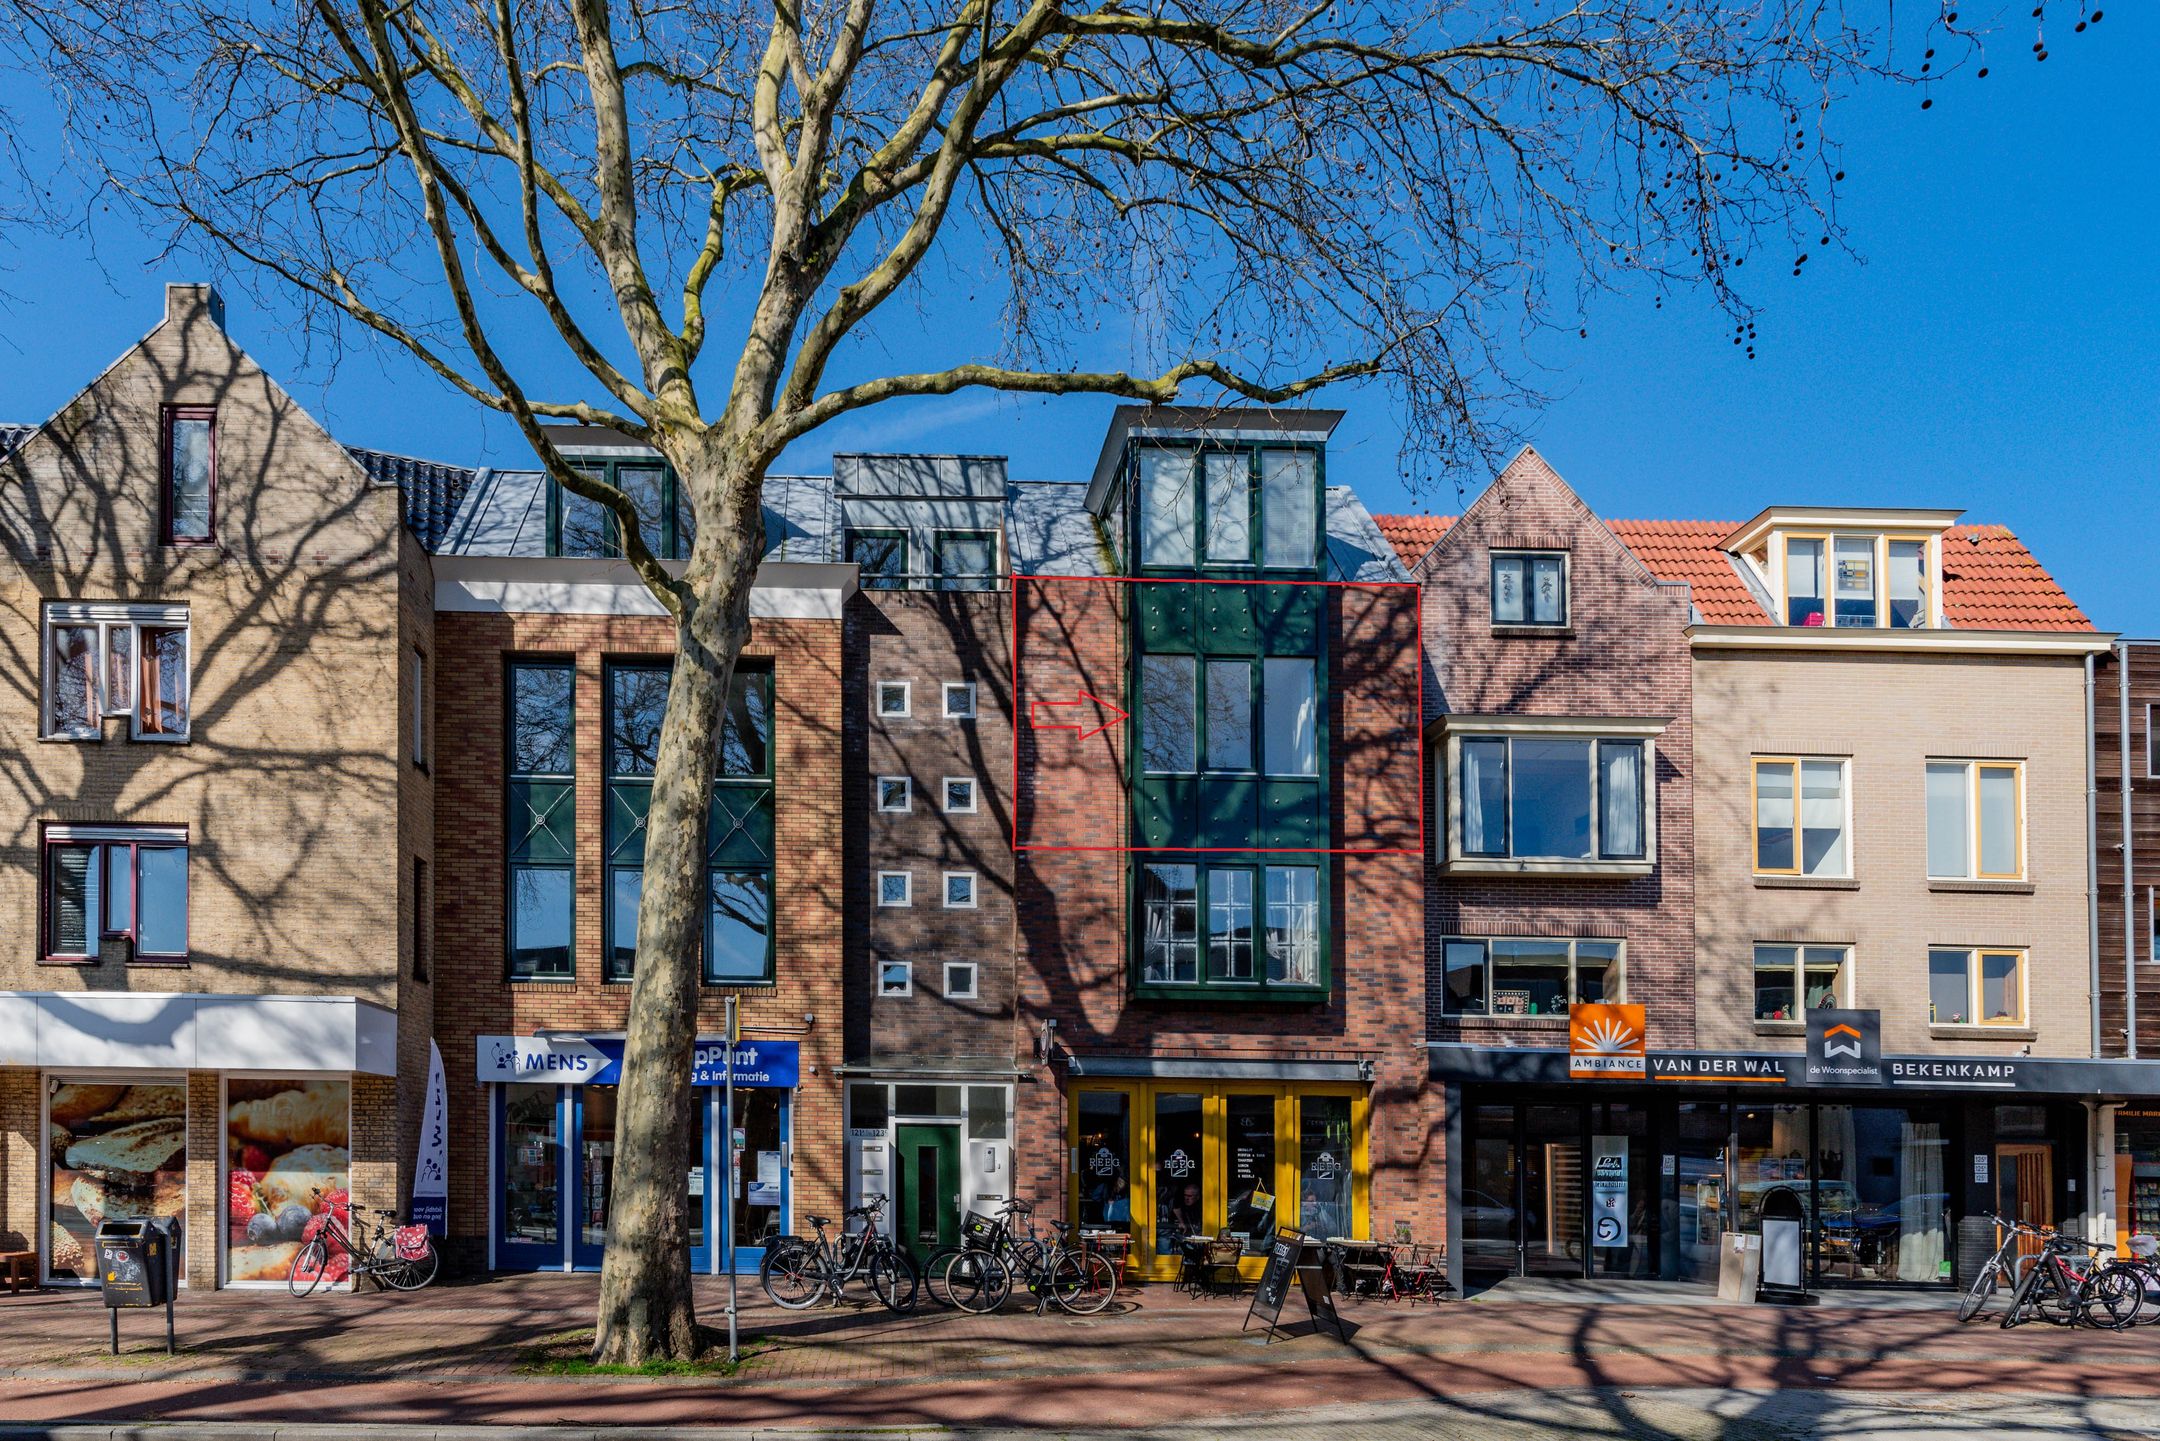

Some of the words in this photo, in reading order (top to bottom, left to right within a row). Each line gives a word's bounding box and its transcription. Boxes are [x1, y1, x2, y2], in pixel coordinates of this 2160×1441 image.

[525, 1053, 588, 1071] MENS
[1574, 1059, 1642, 1069] AMBIANCE
[1653, 1059, 1692, 1072] VAN
[1699, 1059, 1737, 1072] DER
[1744, 1060, 1785, 1073] WAL
[700, 1070, 709, 1081] &
[712, 1070, 770, 1082] Infrmatie
[1809, 1066, 1820, 1074] de
[1821, 1066, 1878, 1076] Woonspecialist
[1892, 1063, 2015, 1078] BEKENKAMP
[1089, 1158, 1120, 1168] REEG
